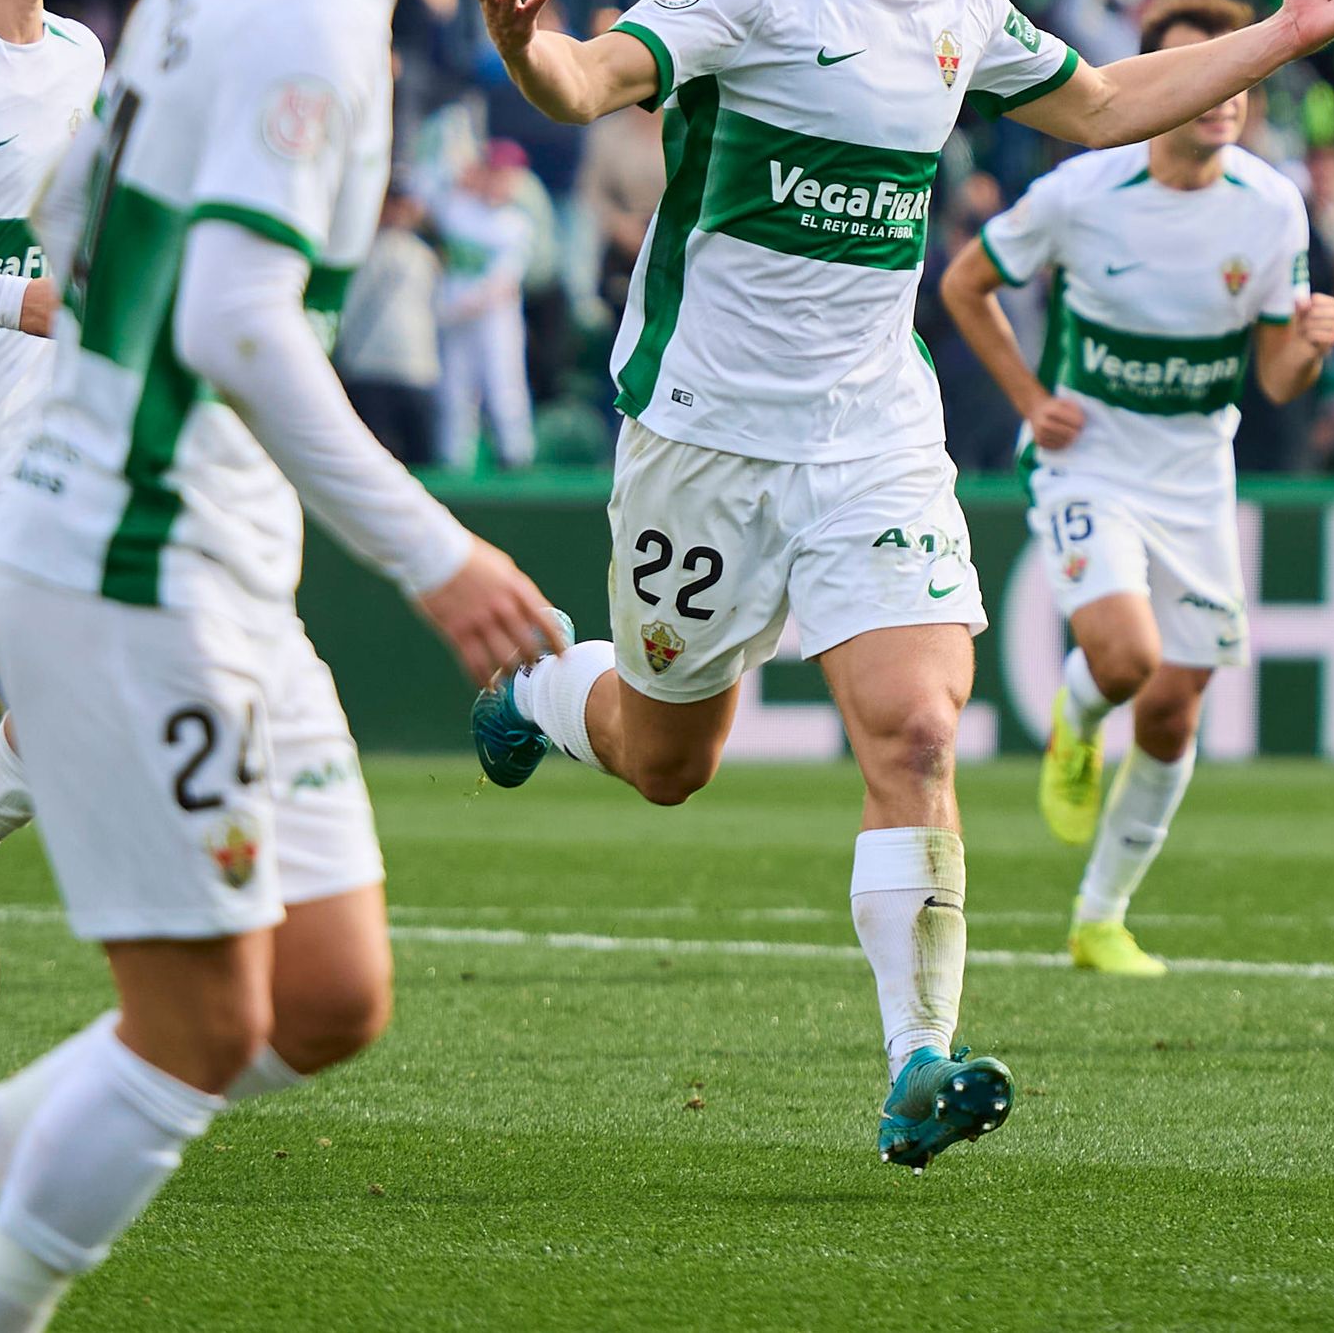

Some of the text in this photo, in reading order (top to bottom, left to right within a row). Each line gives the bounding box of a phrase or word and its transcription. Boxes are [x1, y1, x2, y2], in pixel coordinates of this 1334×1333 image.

[800, 214, 914, 239] EL REY DE LA FIBRA
[1051, 500, 1095, 555] 15
[633, 529, 724, 621] 22
